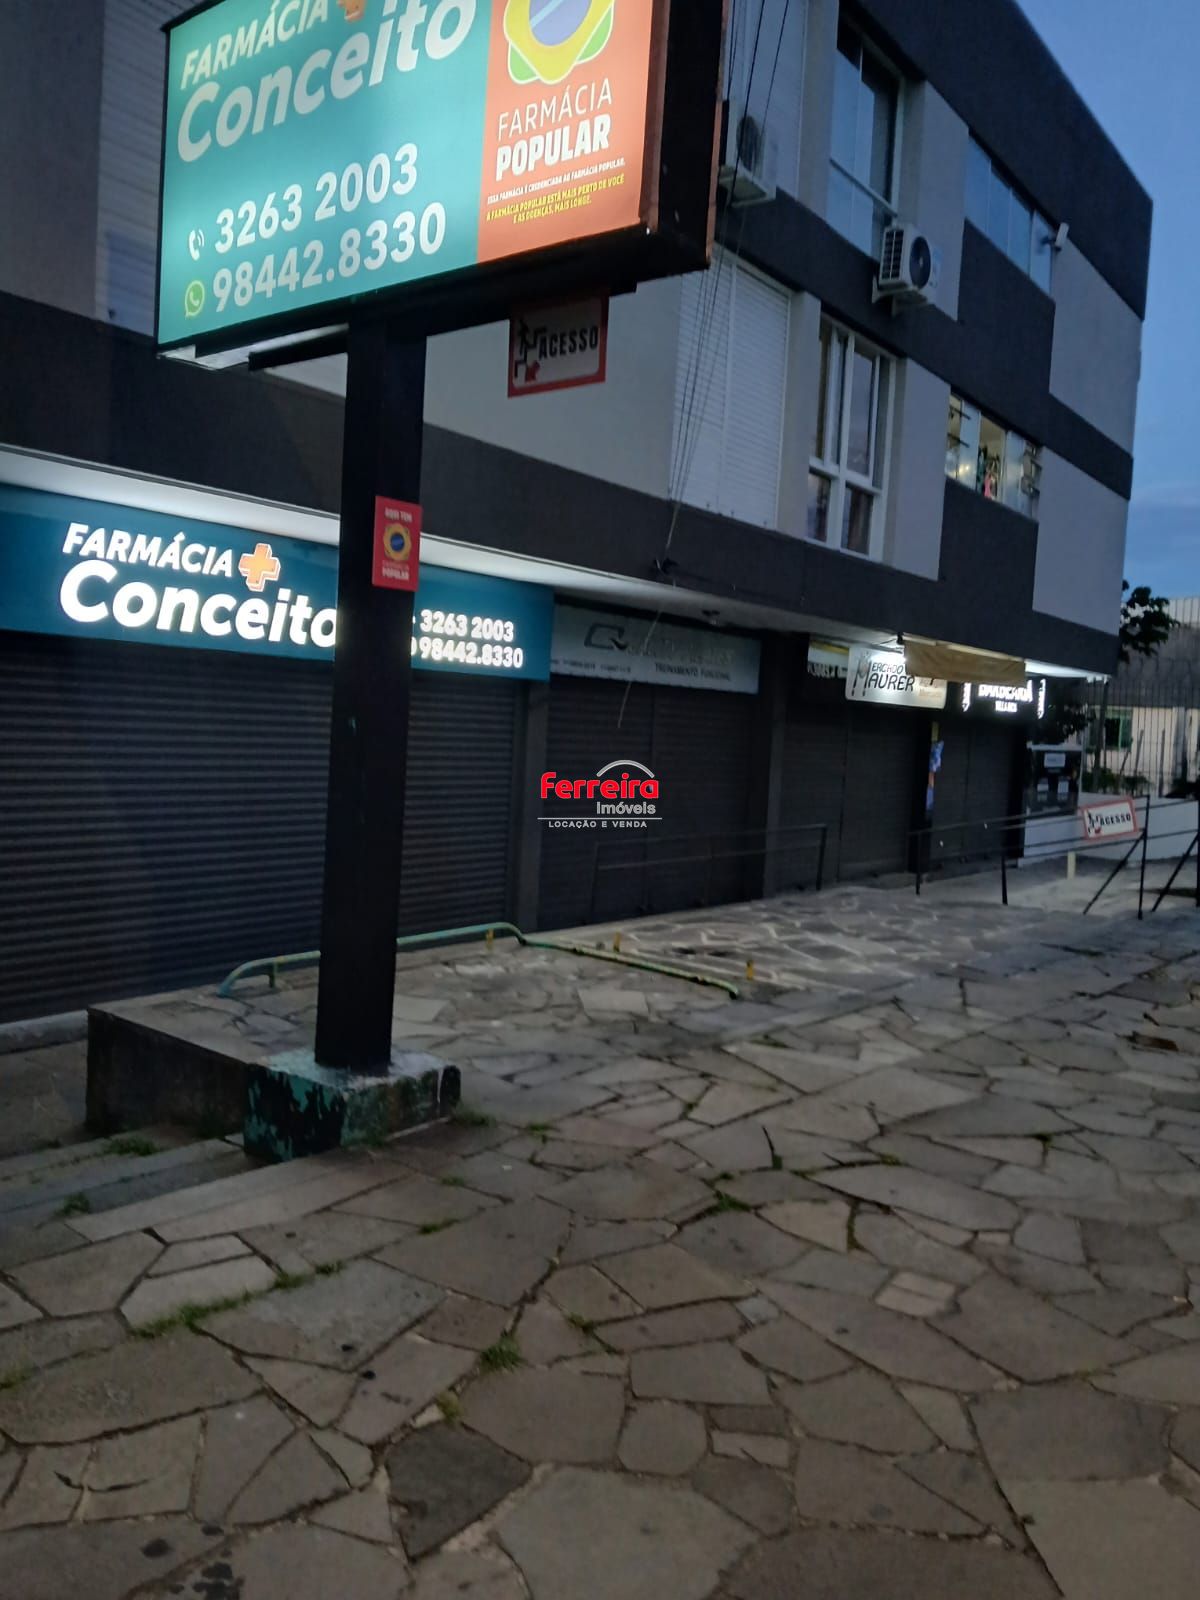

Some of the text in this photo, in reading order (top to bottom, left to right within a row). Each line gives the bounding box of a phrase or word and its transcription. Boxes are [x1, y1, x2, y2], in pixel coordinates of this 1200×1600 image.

[180, 0, 330, 90] FARMÁCIA
[177, 0, 477, 163] Conceito
[497, 77, 613, 143] FARMÁCIA
[495, 114, 610, 182] POPULAR
[214, 143, 419, 256] 3263 2003
[491, 204, 520, 220] FARMÁCIA
[520, 196, 546, 212] POPULAR
[561, 187, 577, 201] MAIS
[578, 182, 597, 197] PERTO
[598, 179, 607, 190] DE
[607, 172, 625, 187] VOCÊ
[500, 187, 524, 200] FARMÁCIA
[571, 165, 598, 181] FARMÁCIA
[555, 200, 570, 213] MAIS
[212, 201, 447, 313] 98442.8330
[538, 325, 599, 360] ACESSO
[62, 522, 233, 577] FARMÁCIA
[59, 559, 337, 649] Conceito
[419, 609, 514, 642] 3263 2003
[419, 637, 523, 668] 98442.8330
[1100, 813, 1131, 826] ACESSO
